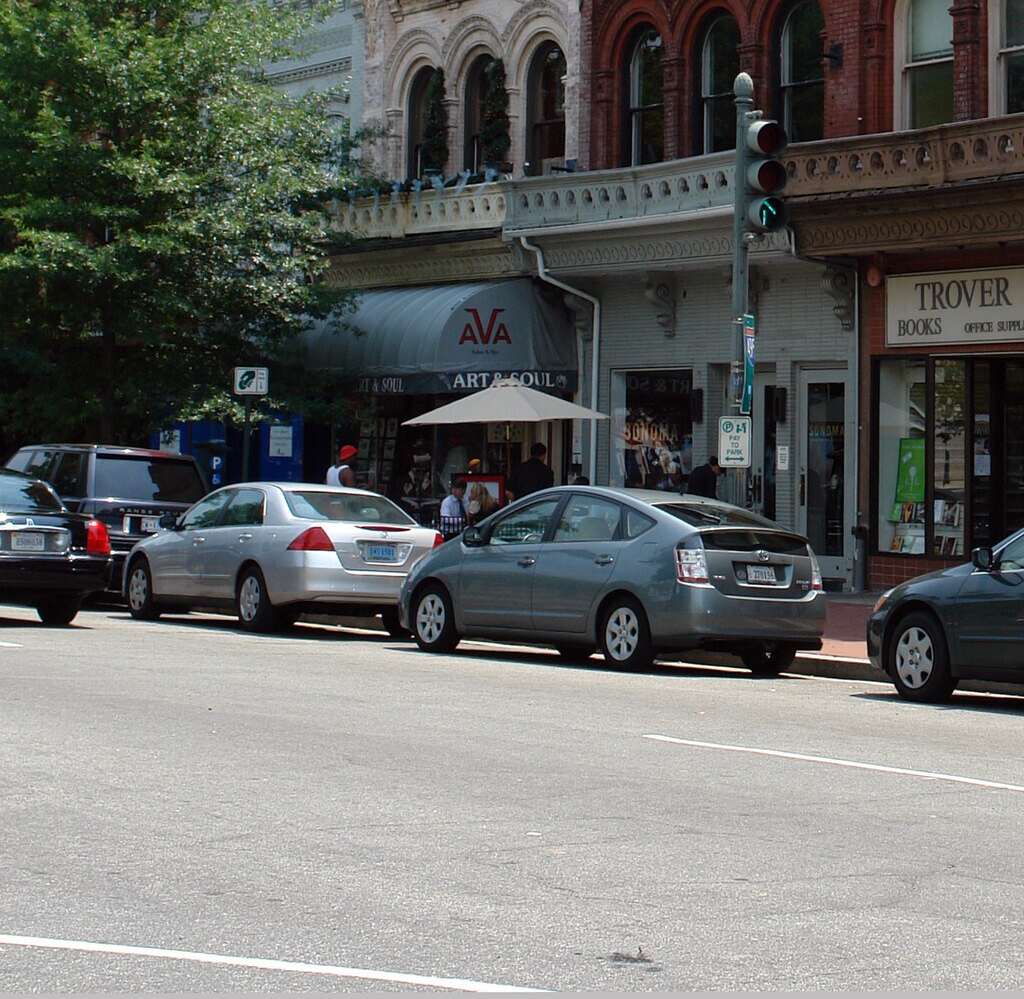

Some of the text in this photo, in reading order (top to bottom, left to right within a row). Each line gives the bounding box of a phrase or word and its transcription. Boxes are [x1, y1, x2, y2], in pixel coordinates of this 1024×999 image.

[915, 276, 1013, 311] TROVER
[458, 308, 513, 345] AVA
[897, 318, 942, 337] BOOKS
[964, 321, 993, 334] OFFICE
[381, 377, 405, 392] SOUL
[453, 371, 491, 389] ART
[625, 422, 679, 441] SONOMA
[808, 425, 845, 436] SONOMA
[213, 456, 221, 470] P
